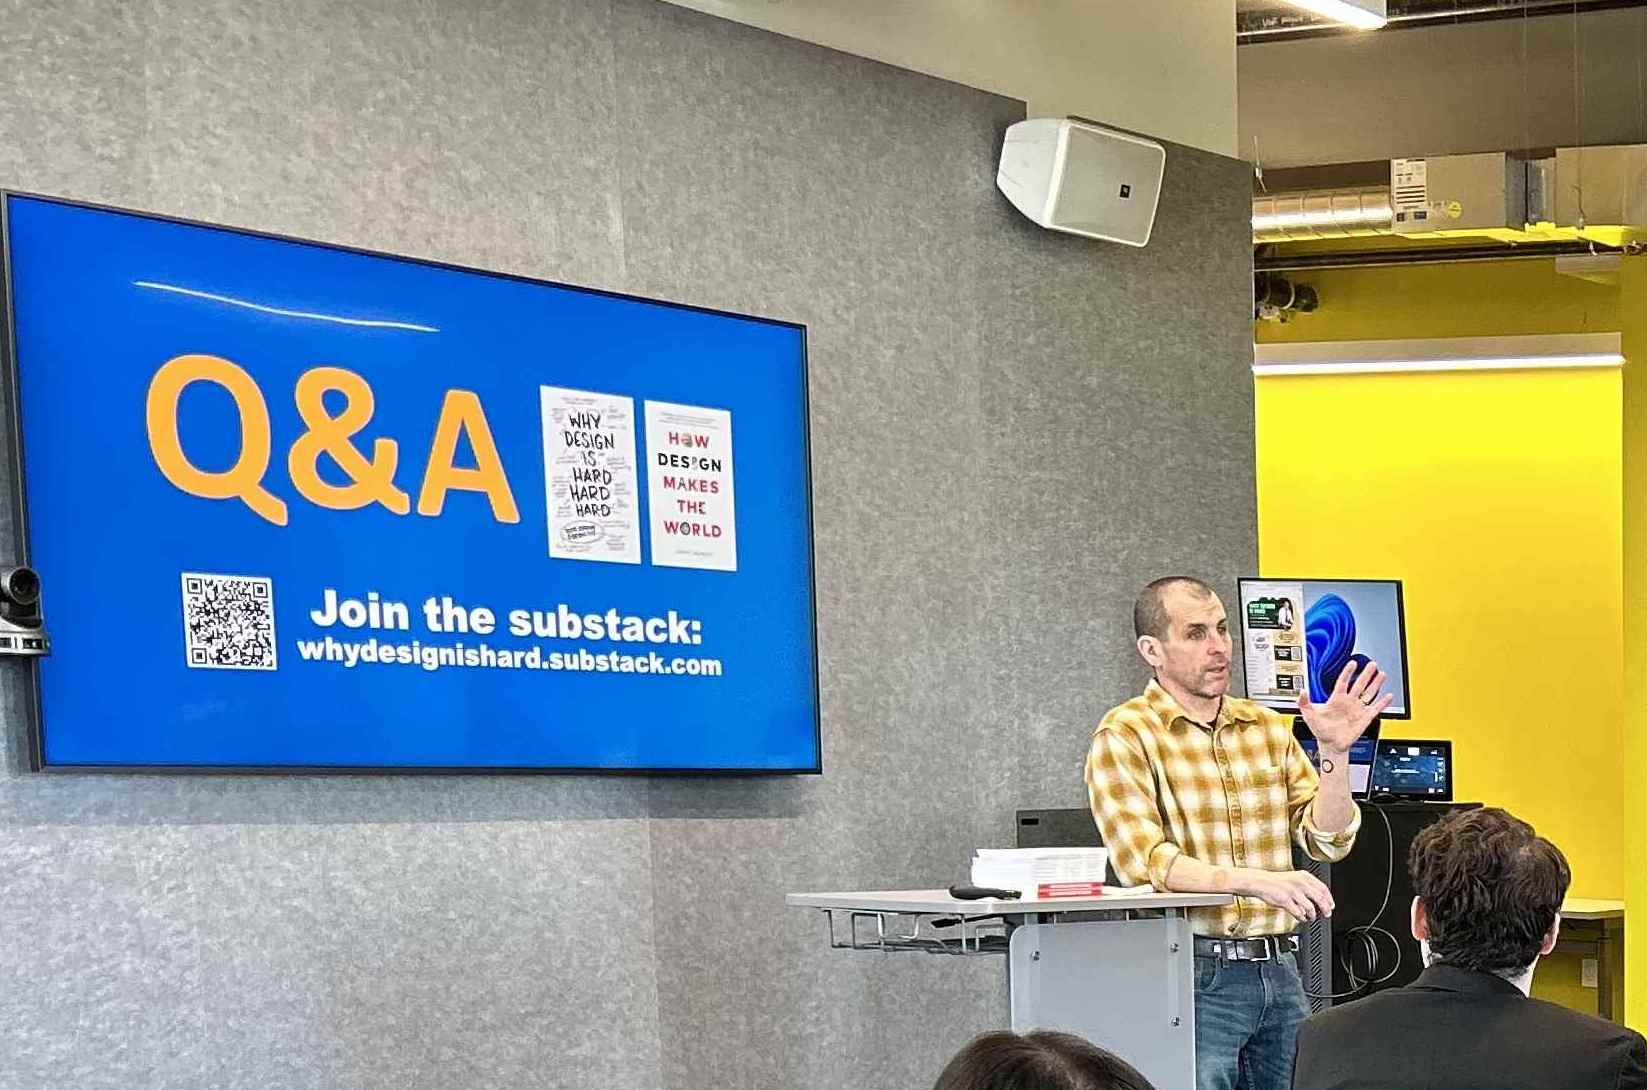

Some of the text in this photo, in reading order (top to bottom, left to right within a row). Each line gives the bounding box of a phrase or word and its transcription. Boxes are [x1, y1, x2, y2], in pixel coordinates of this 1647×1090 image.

[568, 411, 602, 430] WHY
[145, 353, 521, 528] Q&A
[564, 430, 616, 451] DESIGN
[668, 431, 710, 449] HOW
[581, 450, 598, 467] IS
[657, 452, 722, 473] DESIGN
[572, 466, 613, 486] HARD
[663, 475, 720, 494] MAKES
[569, 483, 611, 502] HARD
[575, 503, 611, 518] HARD
[676, 499, 707, 515] THE
[663, 520, 722, 538] WORLD
[310, 588, 703, 646] Join the substack:
[297, 636, 723, 677] whydesignishard.substack.com
